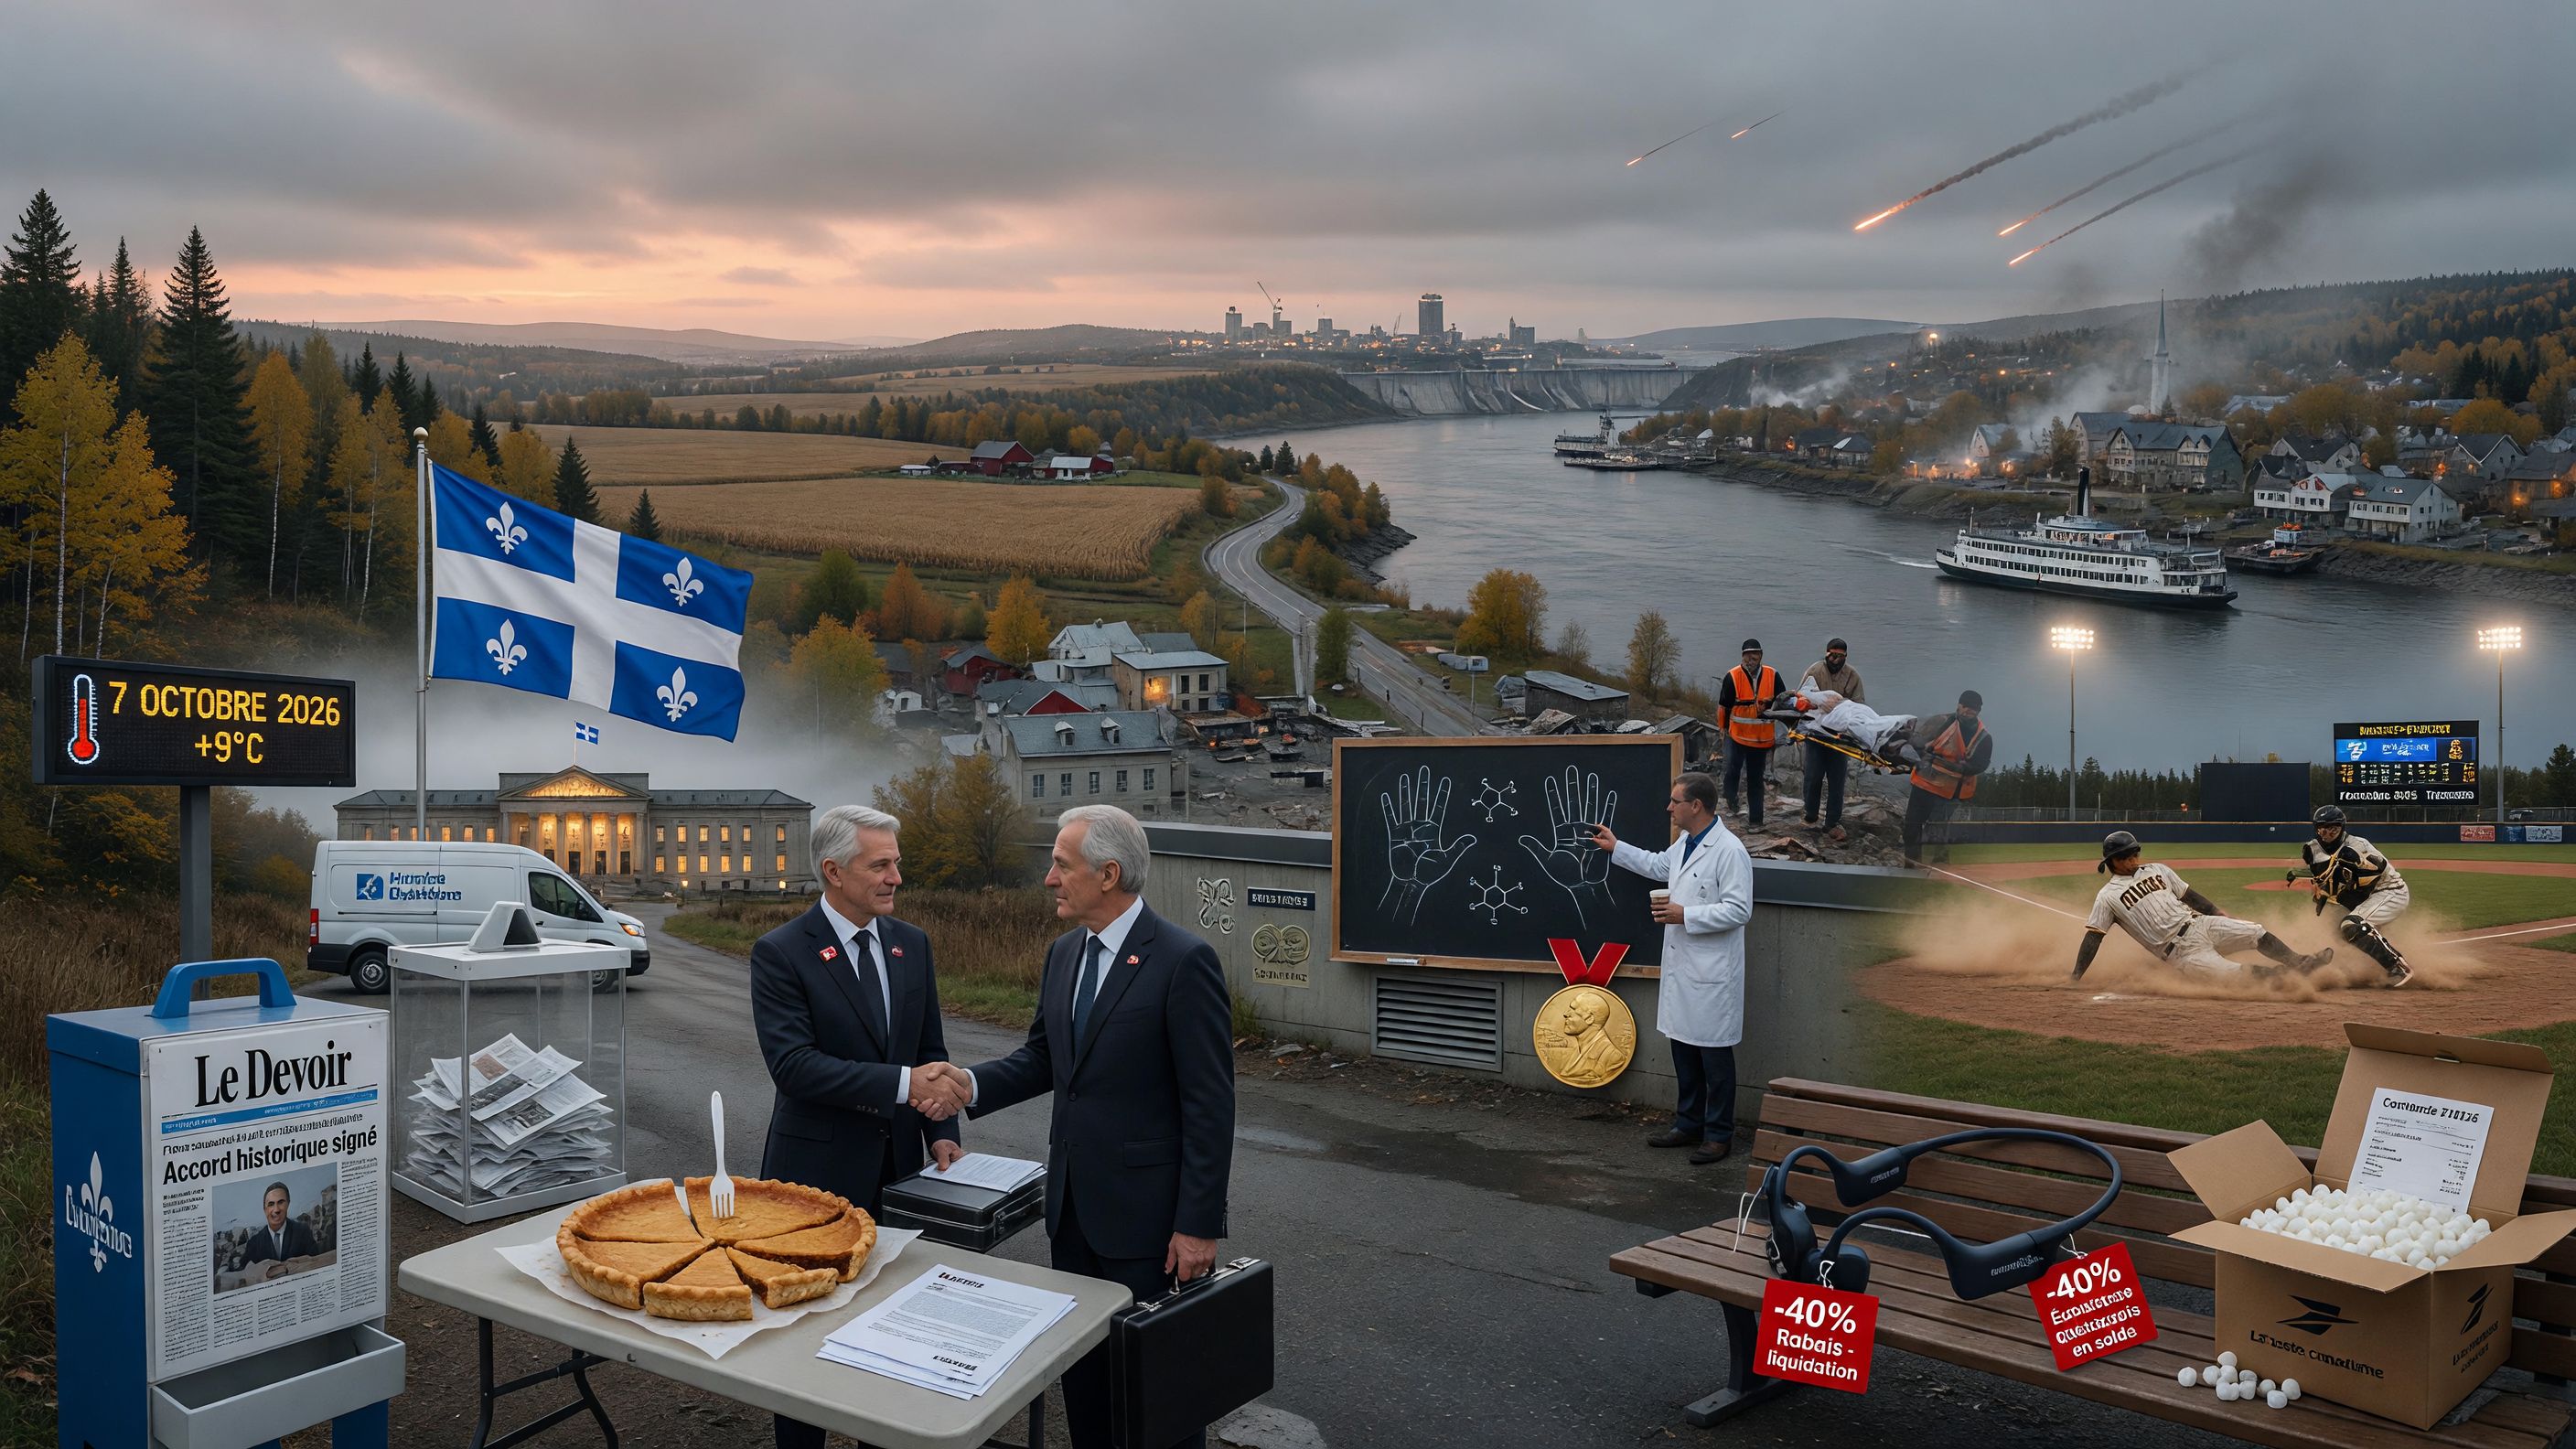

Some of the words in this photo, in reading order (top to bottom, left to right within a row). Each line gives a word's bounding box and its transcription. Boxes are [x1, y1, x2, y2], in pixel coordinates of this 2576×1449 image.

[108, 681, 128, 714] 7
[140, 683, 267, 723] OCTOBRE
[278, 692, 340, 726] 2026
[195, 731, 264, 765] +9°C
[195, 1055, 239, 1108] Le
[245, 1039, 352, 1100] Devoir
[163, 1151, 231, 1186] Accord
[237, 1138, 328, 1172] historique
[332, 1124, 377, 1154] signé
[2046, 1257, 2121, 1299] -40%
[1774, 1296, 1856, 1334] -40%
[1776, 1328, 1842, 1357] Rabais
[2073, 1343, 2093, 1358] en
[2095, 1326, 2138, 1349] solde
[1766, 1349, 1858, 1380] liquidation
